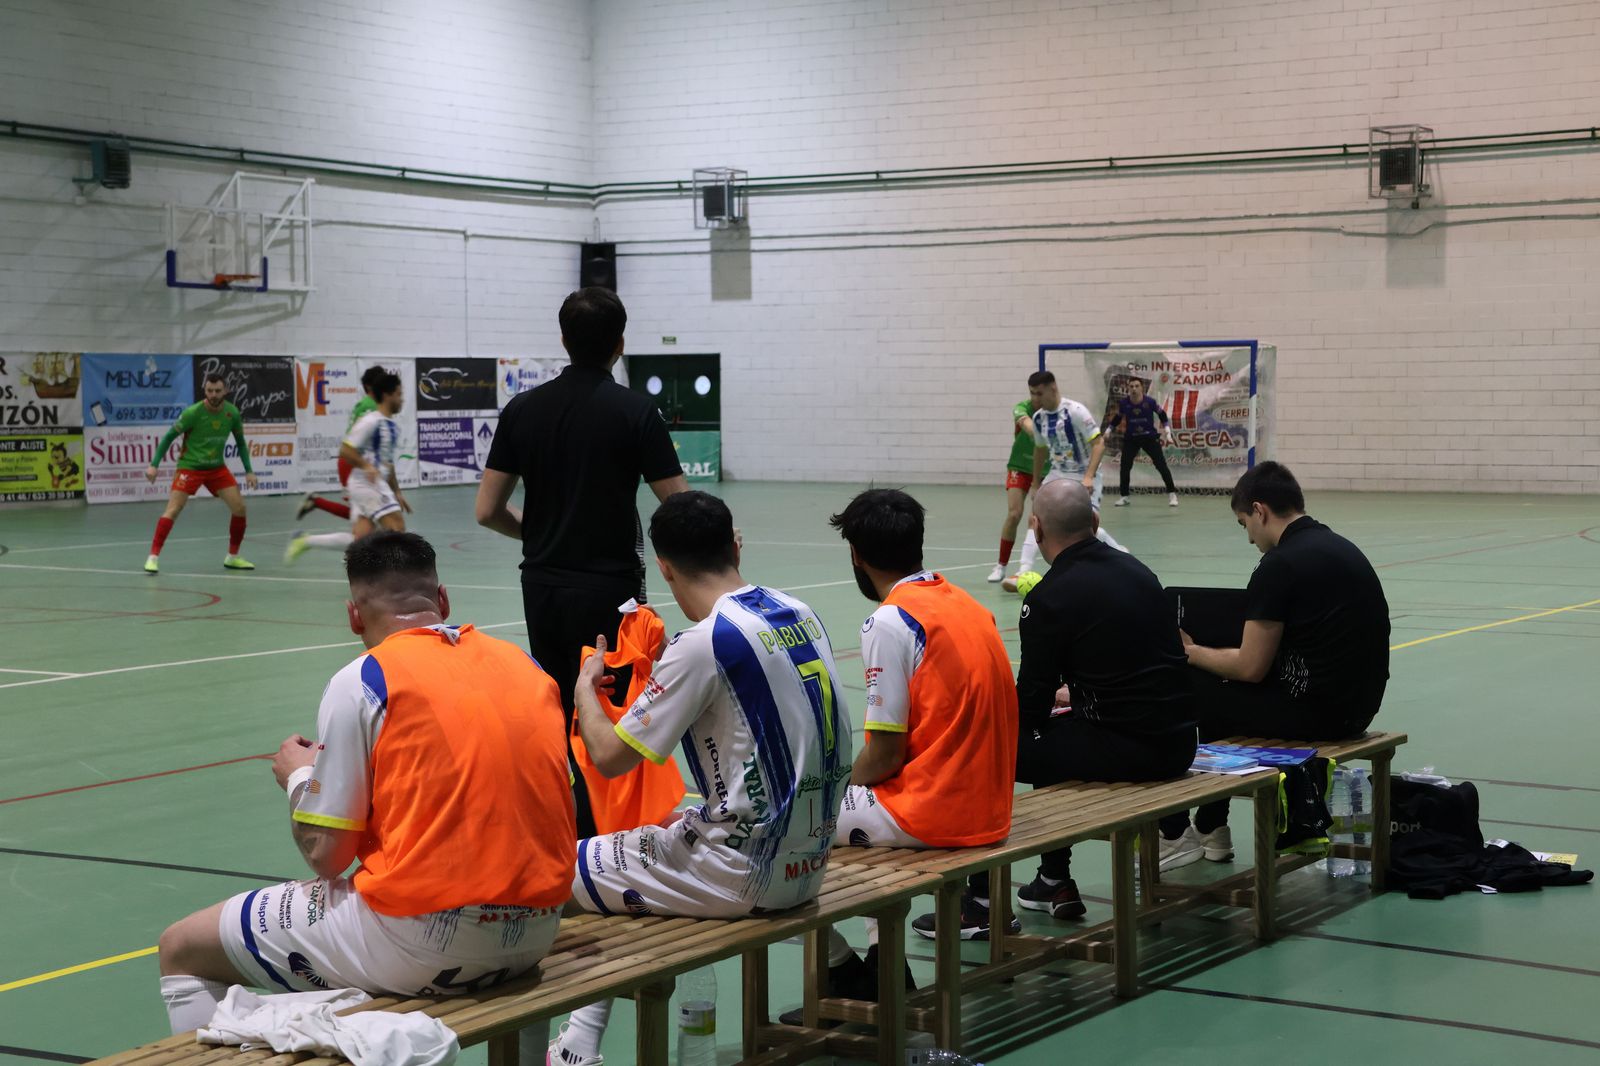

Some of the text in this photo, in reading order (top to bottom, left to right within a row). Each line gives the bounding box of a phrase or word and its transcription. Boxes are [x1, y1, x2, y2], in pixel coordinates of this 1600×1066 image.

[1127, 359, 1225, 373] Con INTERSALA
[105, 370, 171, 388] MENDEZ
[1173, 372, 1233, 385] ZAMORA
[235, 384, 289, 418] Campo
[116, 407, 136, 420] 696
[139, 407, 159, 419] 337
[419, 422, 461, 432] TRANSPORTE
[107, 431, 143, 442] bodegas
[419, 432, 473, 442] INTERNACIONAL
[20, 441, 45, 450] ALISTE
[265, 459, 292, 467] ZAMORA
[757, 617, 822, 655] PABLITO
[796, 658, 835, 757] 7
[593, 840, 606, 875] uhlsport
[639, 834, 649, 870] ZAMORA
[257, 892, 271, 934] uhlsport
[308, 884, 323, 927] ZAMORA
